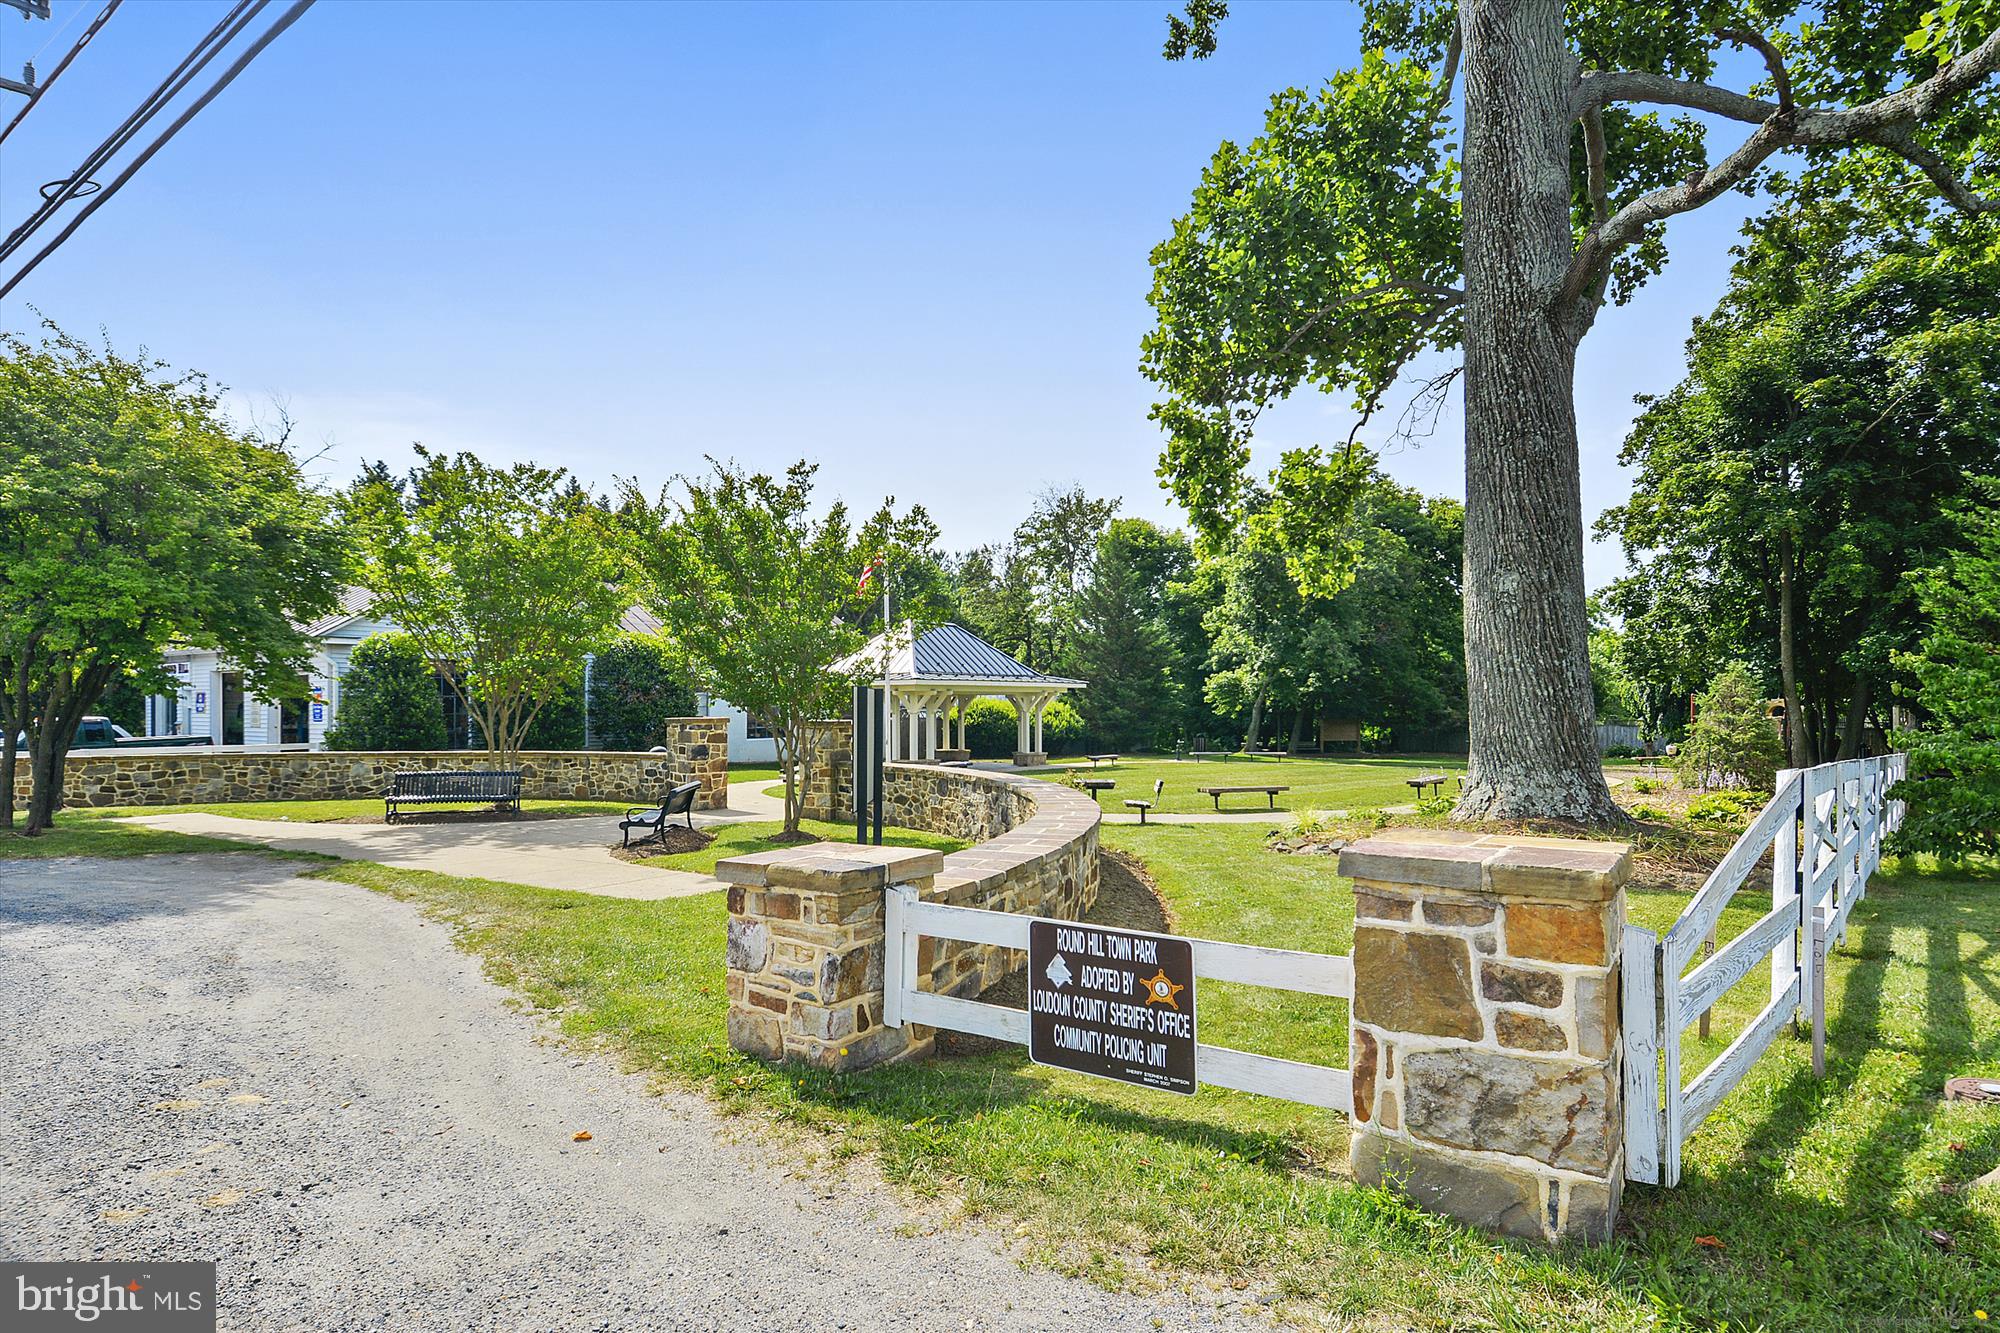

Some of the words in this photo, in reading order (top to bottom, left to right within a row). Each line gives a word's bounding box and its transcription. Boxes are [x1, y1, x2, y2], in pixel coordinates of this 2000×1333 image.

[1056, 928, 1086, 954] ROUND
[1087, 932, 1105, 958] HILL
[1106, 935, 1132, 961] TOWN
[1134, 939, 1158, 965] PARK
[1080, 965, 1120, 993] ADOPTED
[1123, 971, 1135, 996] BY
[1033, 989, 1071, 1017] LOUDOUN
[1073, 996, 1107, 1024] COUNTY
[1110, 1003, 1155, 1033] SHERIFF'S
[1157, 1012, 1191, 1039] OFFICE
[1053, 1023, 1102, 1055] COMMUNITY
[1104, 1033, 1144, 1063] POLICING
[1146, 1042, 1168, 1068] UNIT
[1125, 1068, 1143, 1076] SHERIFF
[1143, 1071, 1163, 1080] STEPHEN
[1169, 1077, 1190, 1086] SIMPSON
